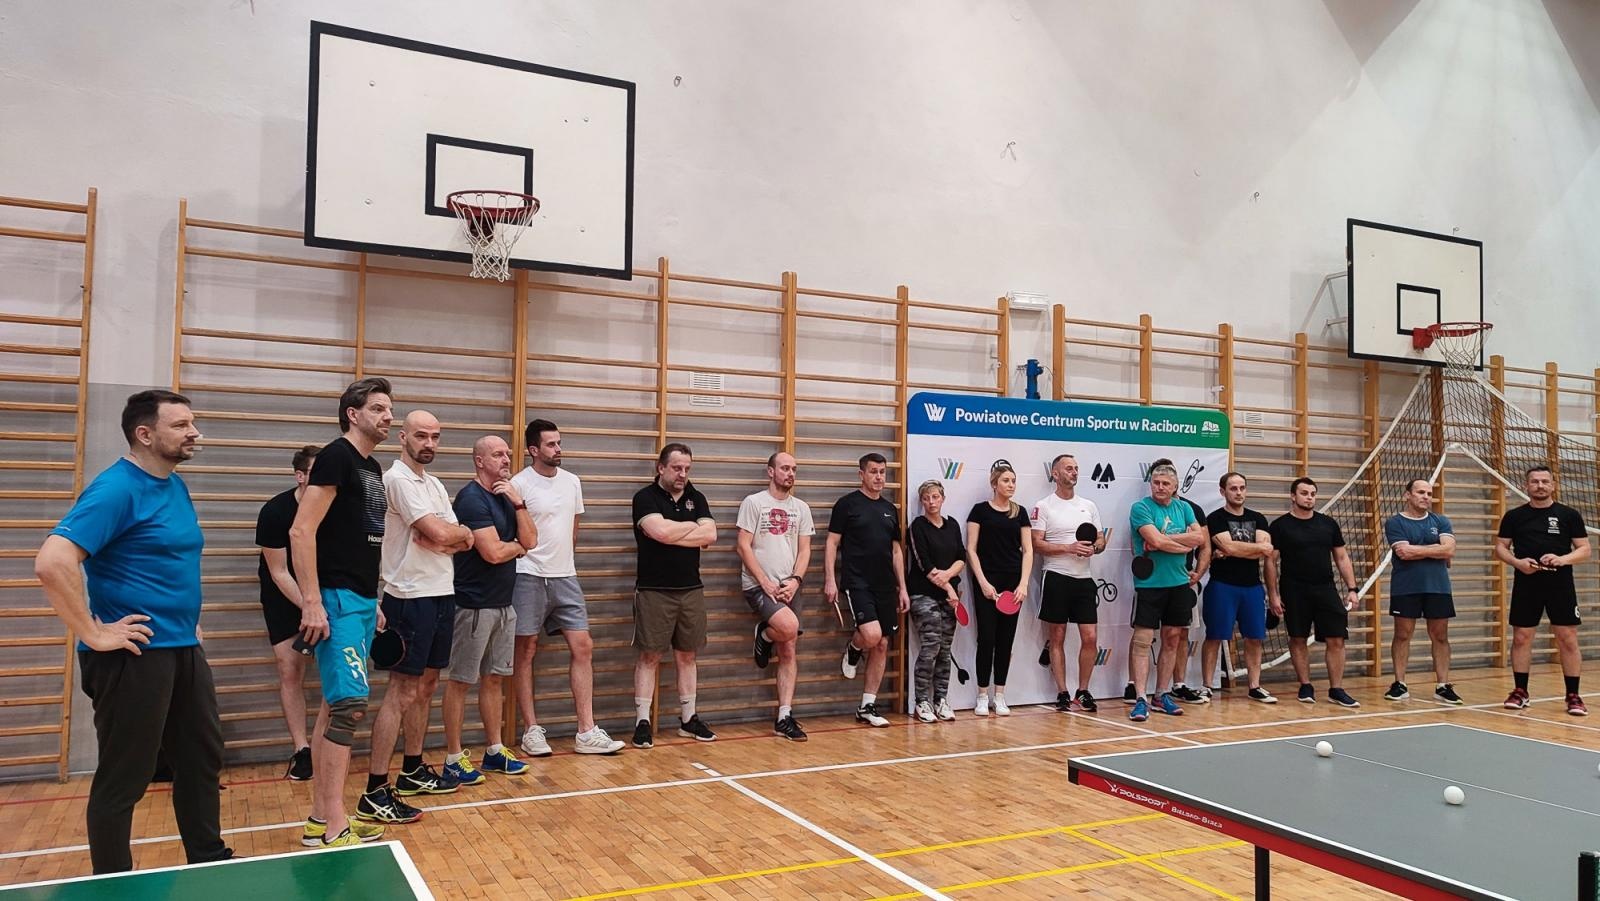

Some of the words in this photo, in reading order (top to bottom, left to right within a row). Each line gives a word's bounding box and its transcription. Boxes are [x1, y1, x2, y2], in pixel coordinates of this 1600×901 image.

[955, 407, 1028, 426] Powiatowe
[1030, 412, 1084, 428] Centrum
[1087, 415, 1127, 432] Sportu
[1129, 421, 1140, 430] w
[1142, 419, 1197, 435] Raciborzu
[1119, 788, 1167, 809] POLSPORT
